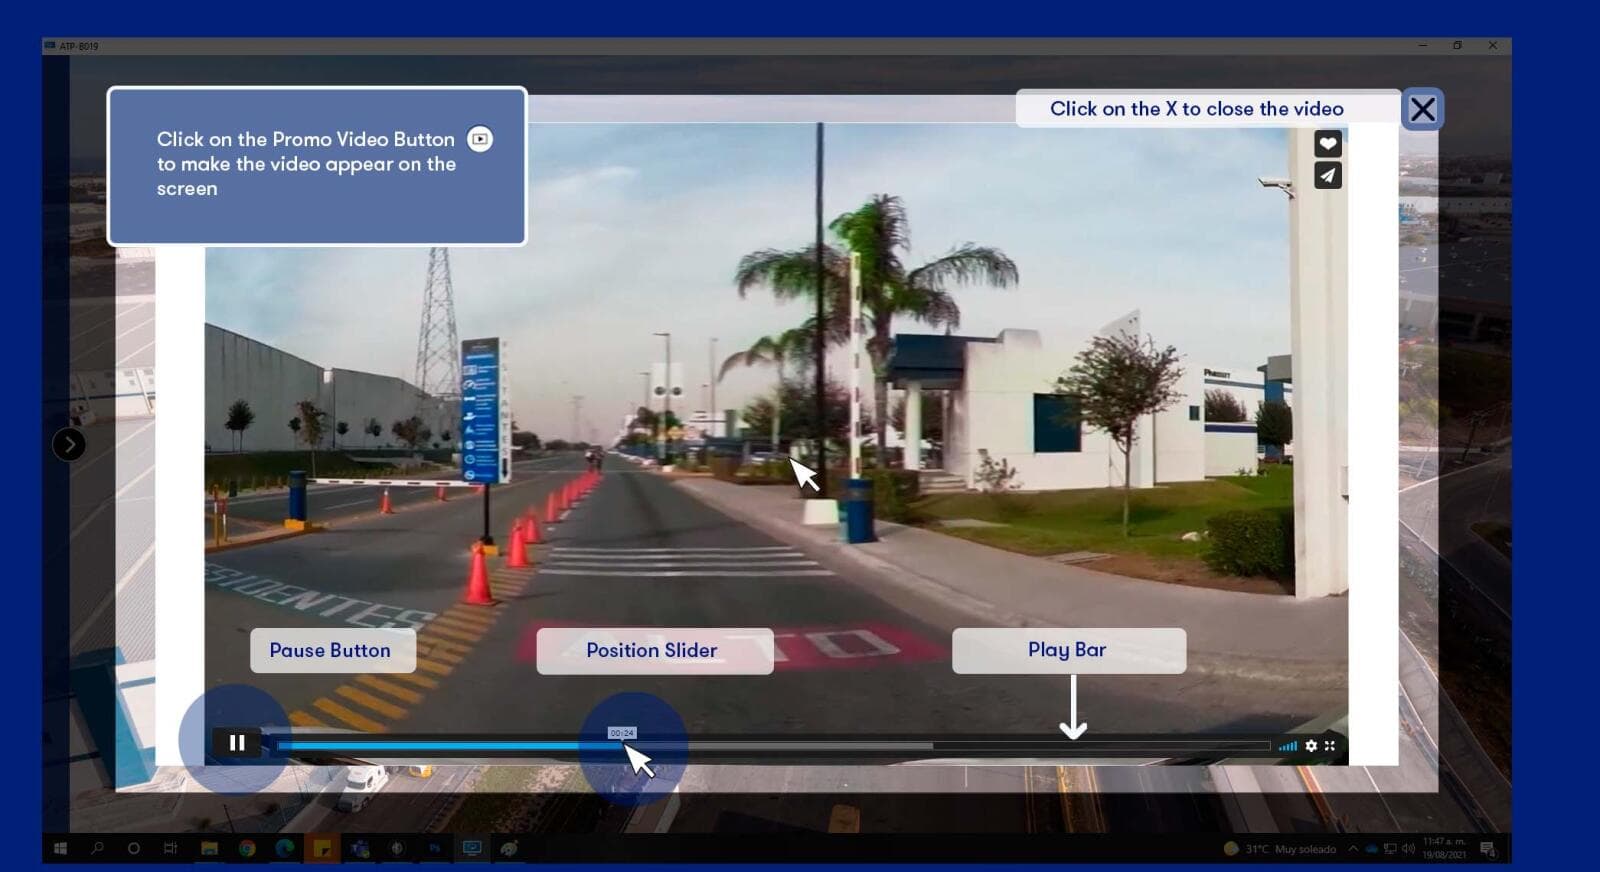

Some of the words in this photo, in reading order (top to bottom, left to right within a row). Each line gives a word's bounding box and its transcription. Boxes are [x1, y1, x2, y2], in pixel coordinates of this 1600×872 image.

[611, 729, 634, 737] 00:24
[1423, 837, 1445, 846] 11:47
[1246, 844, 1269, 854] 31°C
[1275, 844, 1297, 857] Muy
[1300, 844, 1337, 855] soleado
[1423, 850, 1467, 860] 19/08/2021
